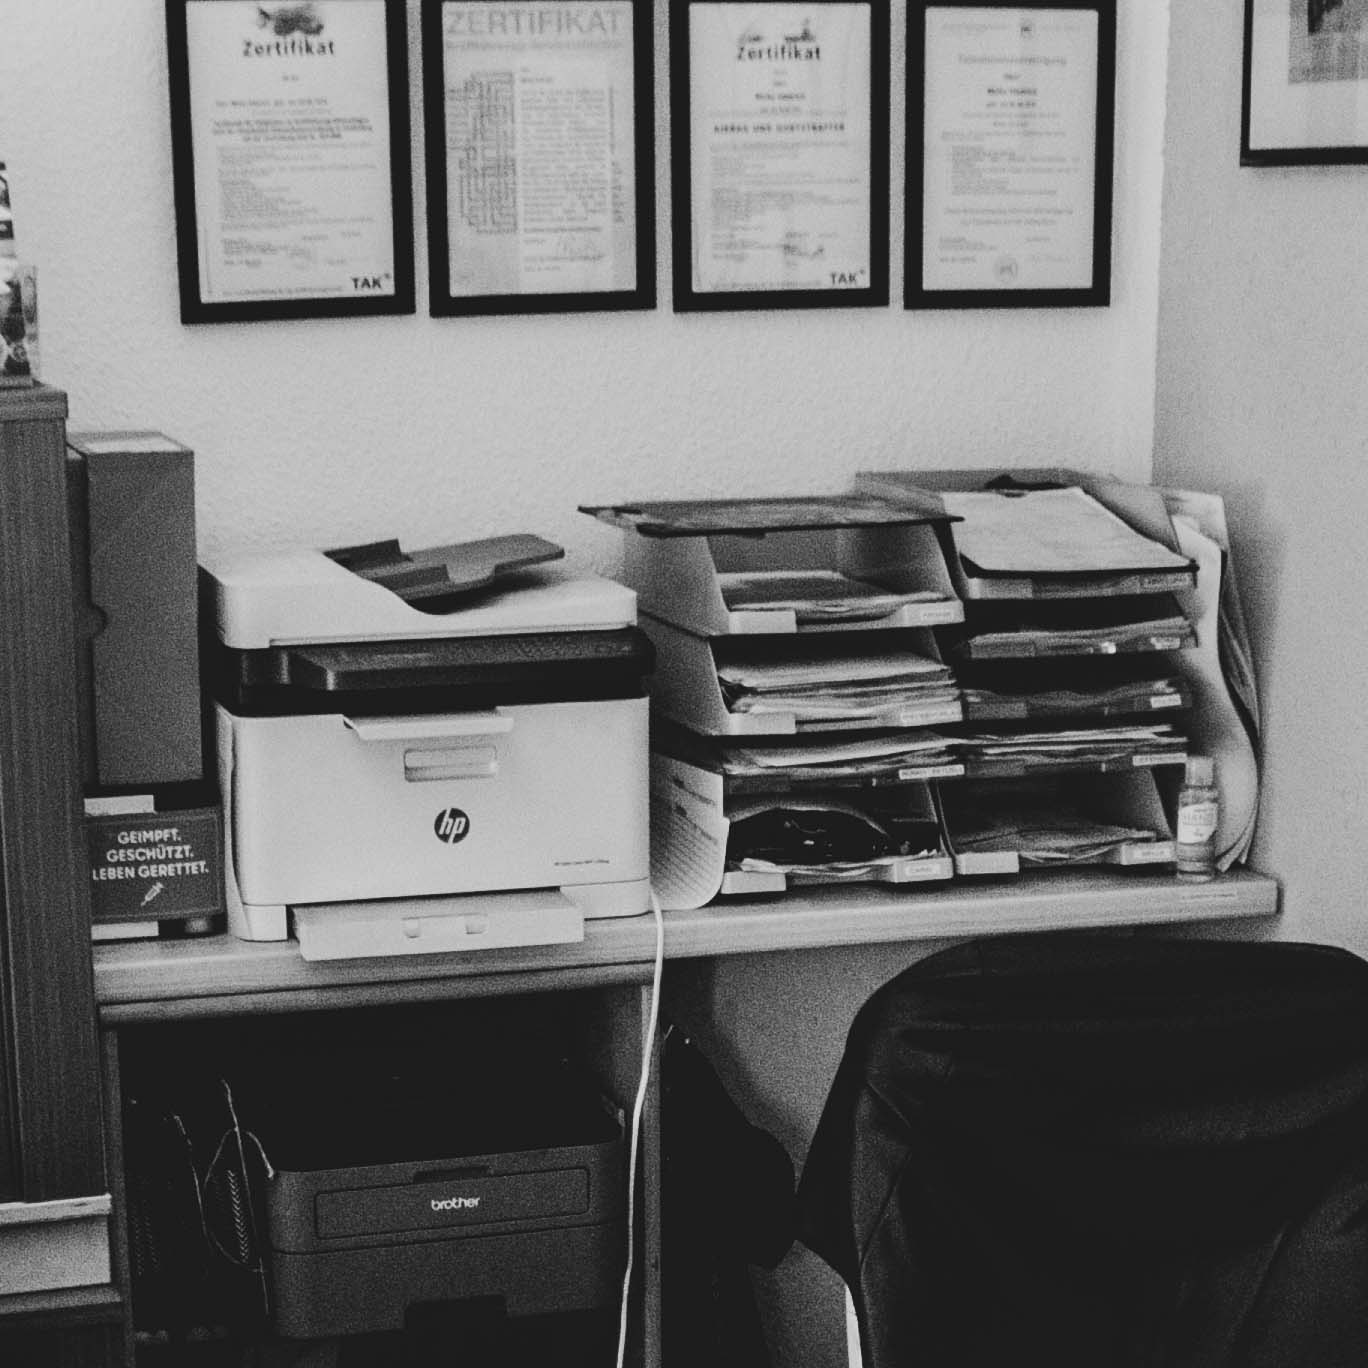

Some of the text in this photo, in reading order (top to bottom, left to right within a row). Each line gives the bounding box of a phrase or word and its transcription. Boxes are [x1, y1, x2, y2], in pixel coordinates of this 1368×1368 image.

[447, 9, 623, 35] ZERTIFIKAT
[243, 39, 335, 57] Zertifikat
[736, 45, 822, 62] Zertifikat
[351, 276, 383, 291] TAK
[829, 272, 857, 286] TAK
[436, 808, 469, 843] hp
[117, 827, 181, 845] GEIMPFT.
[106, 844, 195, 863] GESCHÜTZT.
[92, 860, 210, 881] LEBEN GERETTET.
[431, 1197, 481, 1211] brother
